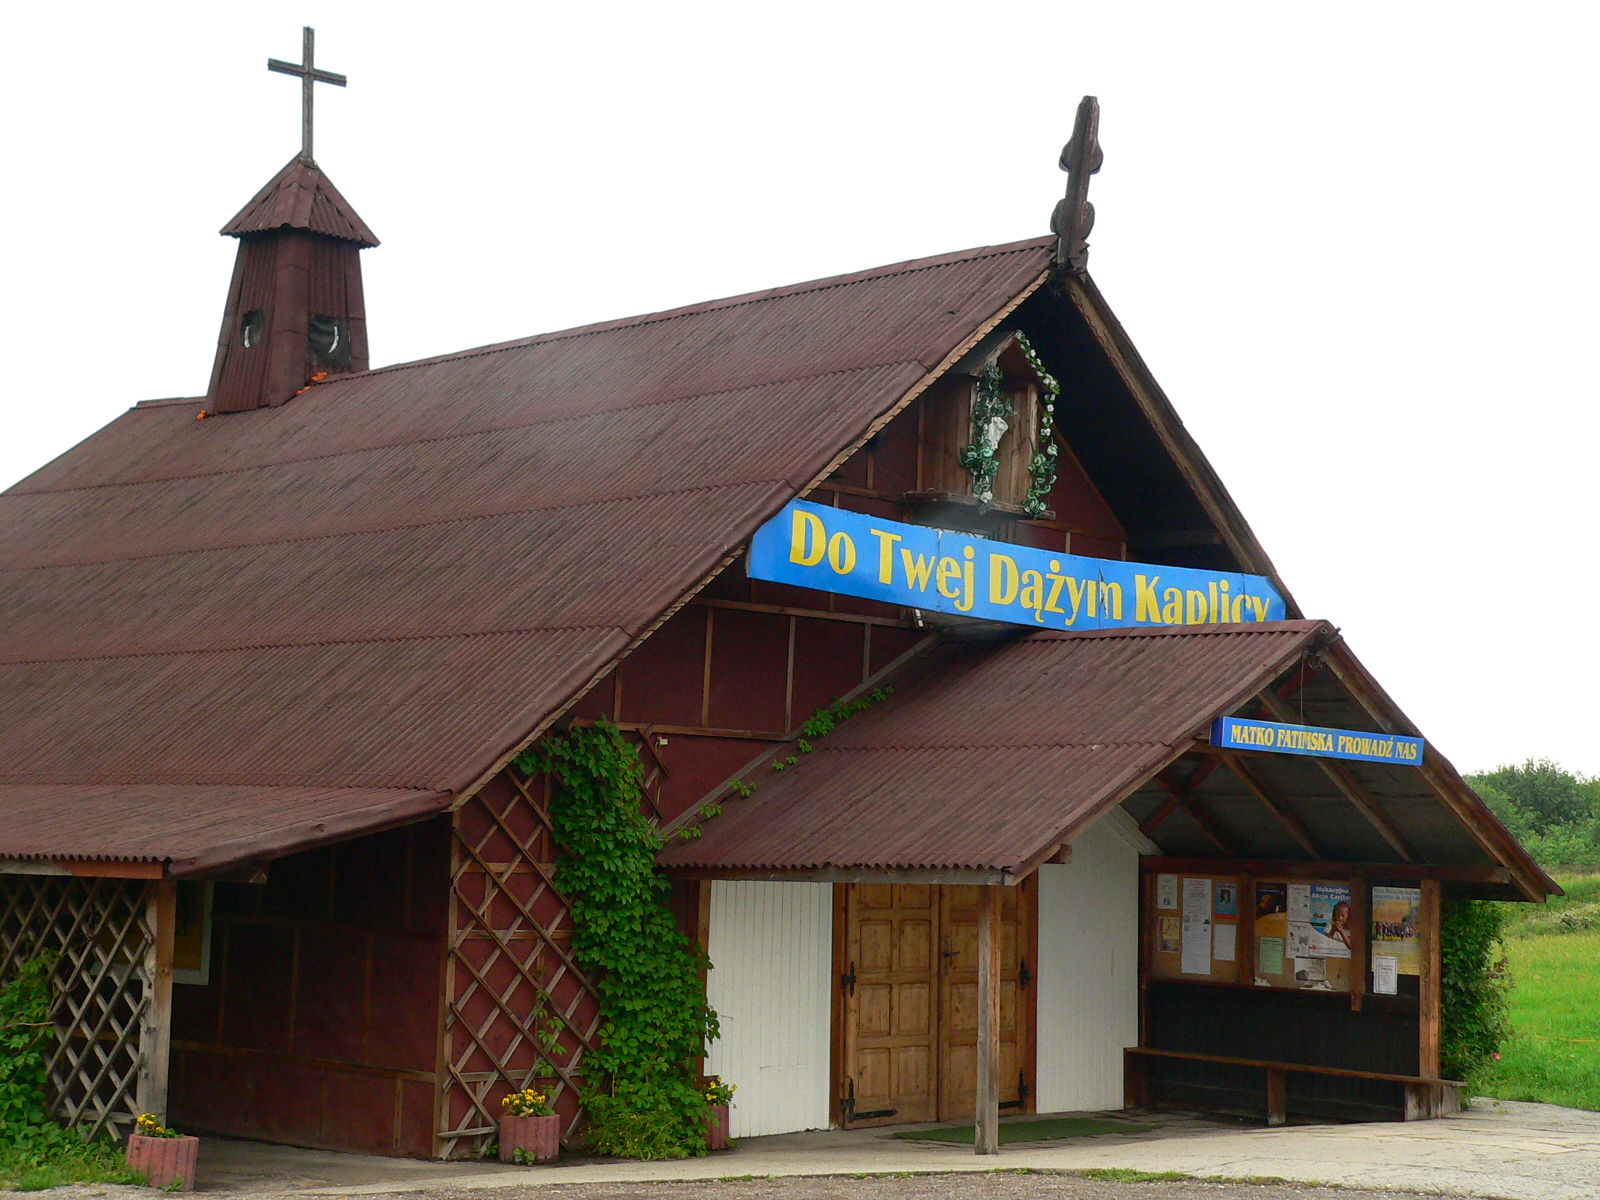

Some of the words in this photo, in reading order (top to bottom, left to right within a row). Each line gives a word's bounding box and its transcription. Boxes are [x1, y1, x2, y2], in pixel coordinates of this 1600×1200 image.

[789, 509, 857, 575] Do
[870, 528, 975, 612] Twej
[989, 553, 1122, 626] Dążym
[1135, 574, 1271, 625] Kaplicy
[1231, 725, 1275, 746] MATKO
[1277, 729, 1334, 752] FATIMSKA
[1337, 735, 1394, 757] PROWADŹ
[1395, 741, 1418, 760] NAS
